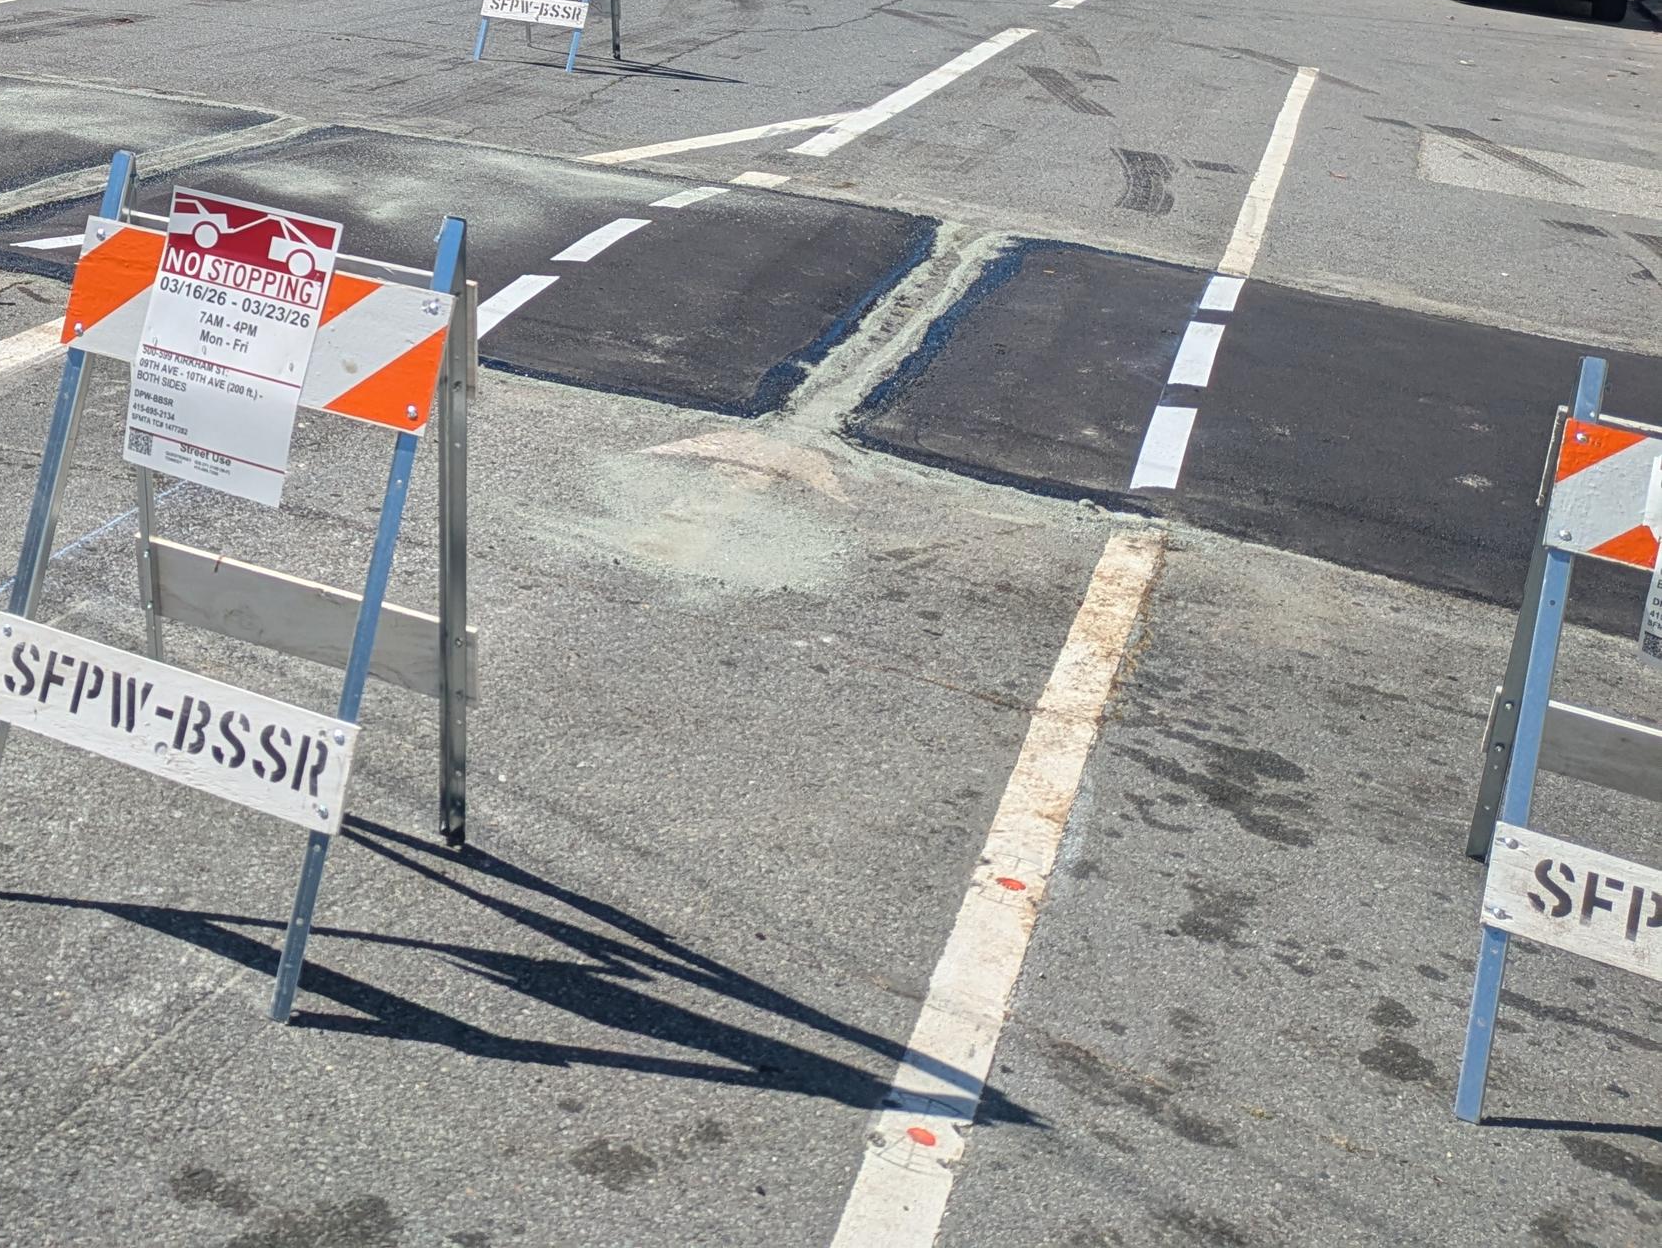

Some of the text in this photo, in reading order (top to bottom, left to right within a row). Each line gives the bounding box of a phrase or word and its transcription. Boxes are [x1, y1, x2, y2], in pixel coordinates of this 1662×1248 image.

[166, 247, 314, 304] NO STOPPING
[160, 276, 227, 306] 03/16/26
[242, 297, 310, 328] 03/23/26
[199, 311, 224, 328] 7AM
[233, 321, 258, 337] 4PM
[199, 329, 223, 346] Mon
[233, 339, 249, 353] Fri
[142, 346, 172, 360] 500-599
[174, 353, 214, 372] KIRKHAM
[137, 370, 187, 392] BOTH SIDES
[139, 358, 160, 370] 09TH
[161, 364, 178, 376] AVE
[186, 371, 206, 384] 10TH
[207, 377, 226, 390] AVE
[227, 382, 244, 395] (200
[180, 442, 209, 459] Street
[212, 452, 231, 466] Use
[4, 641, 328, 797] SFPW-BSSR
